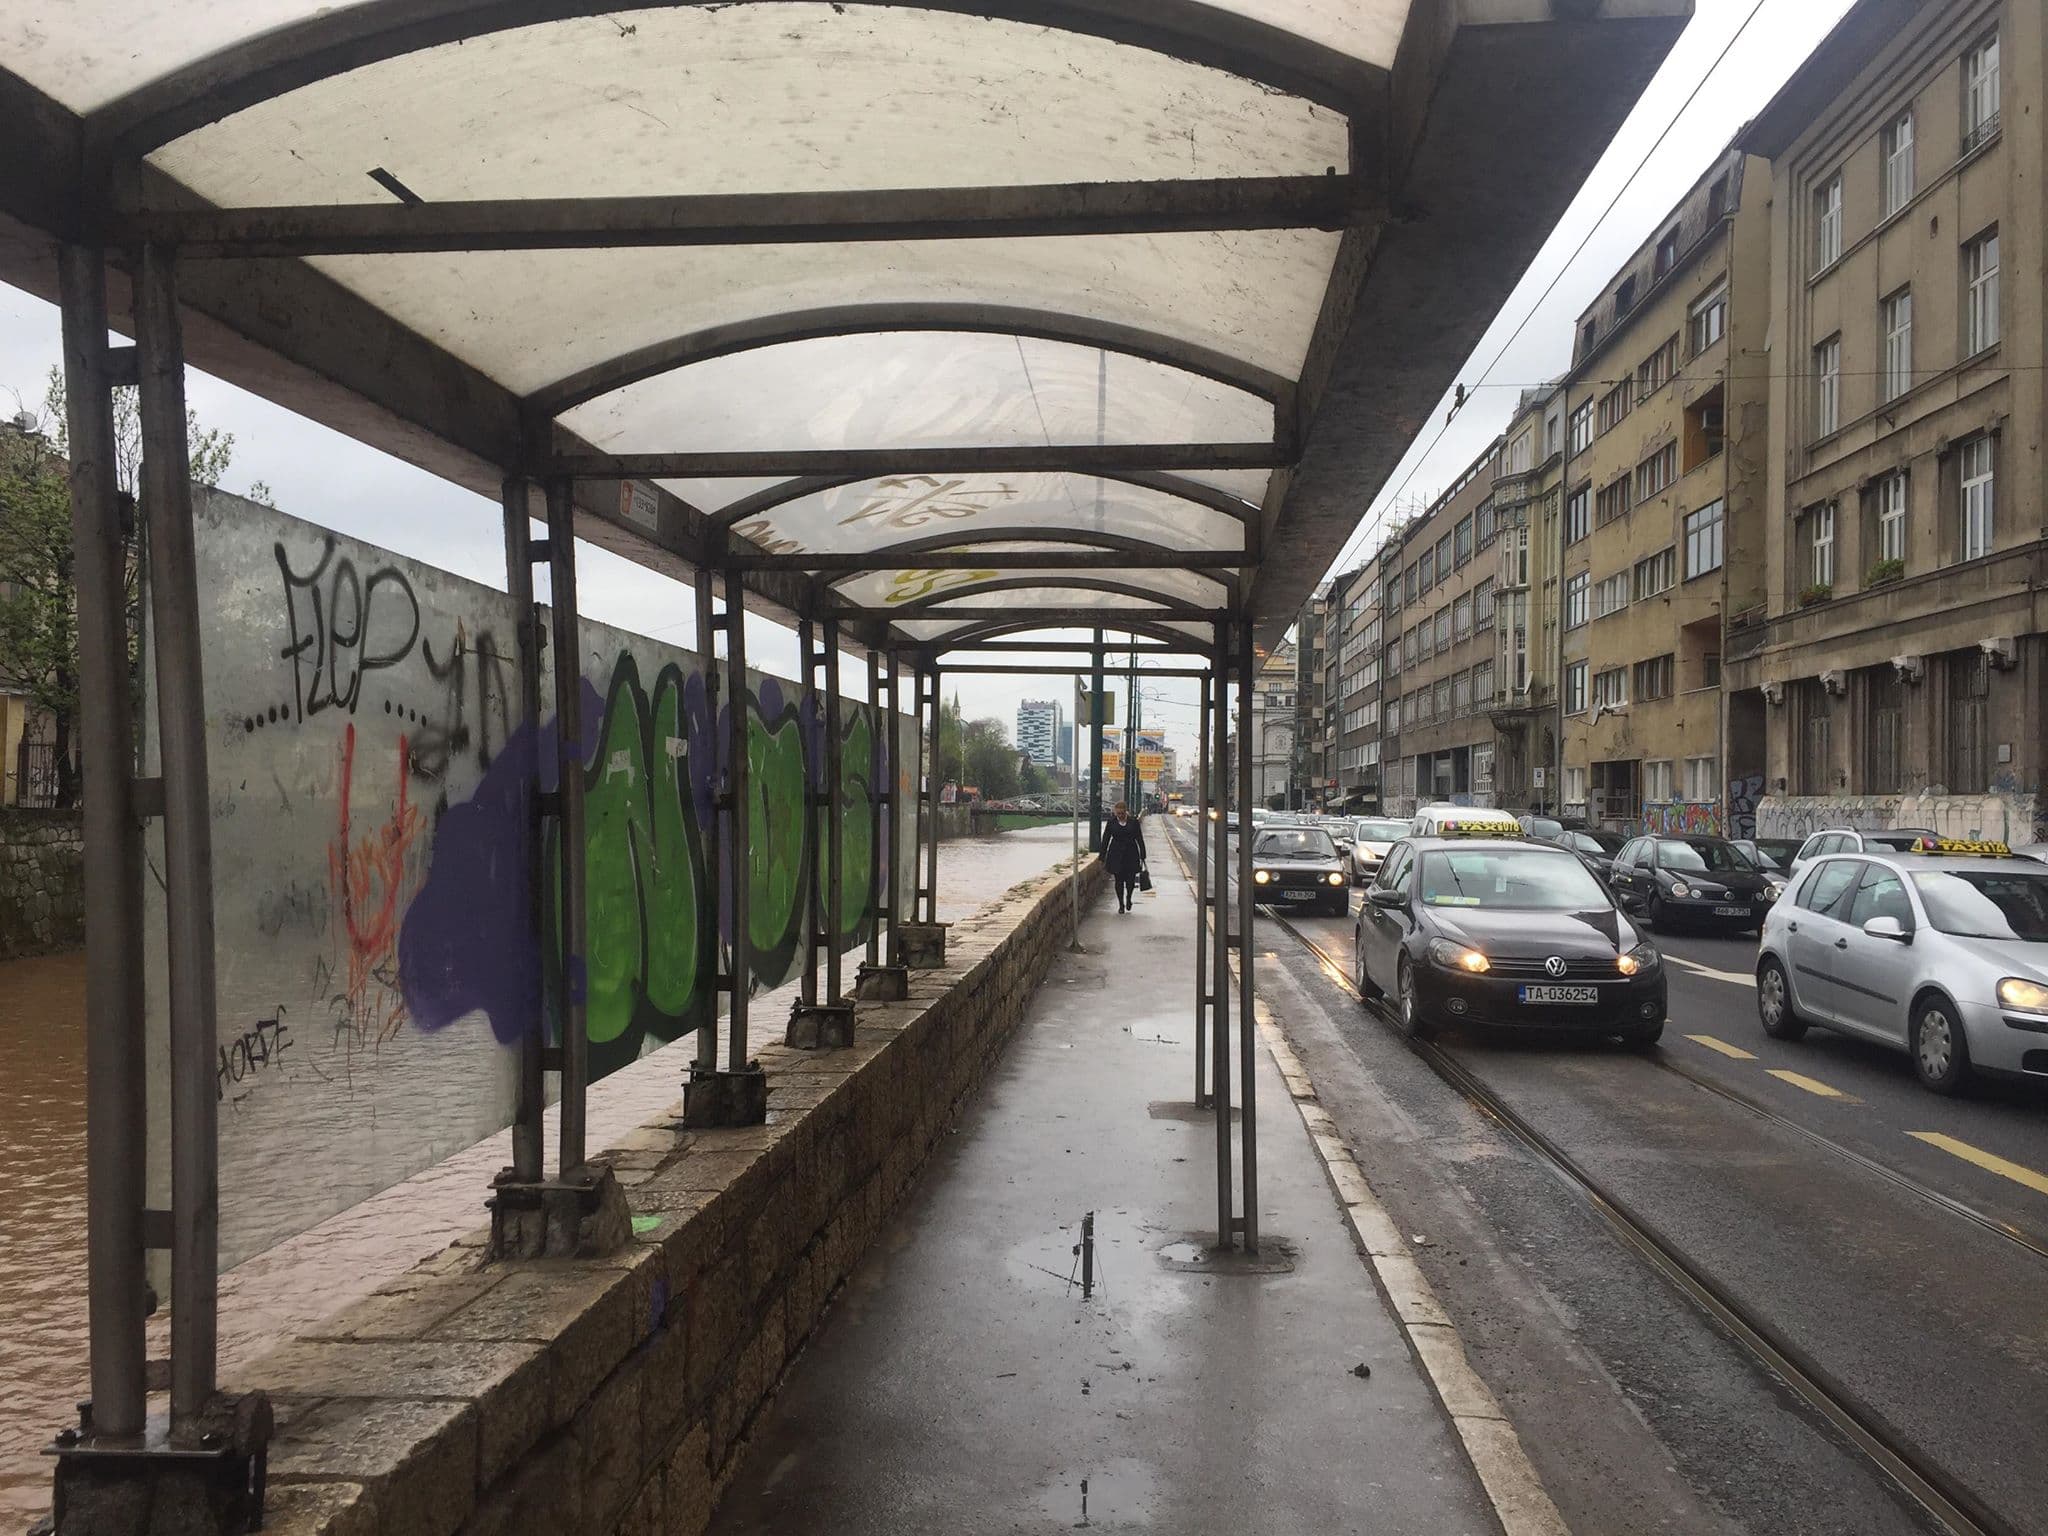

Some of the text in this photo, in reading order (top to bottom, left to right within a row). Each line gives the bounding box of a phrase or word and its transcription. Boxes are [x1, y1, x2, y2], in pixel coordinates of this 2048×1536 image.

[1460, 823, 1503, 832] TAXI
[1940, 842, 1989, 852] TAXI
[1526, 986, 1597, 1001] TA-036254
